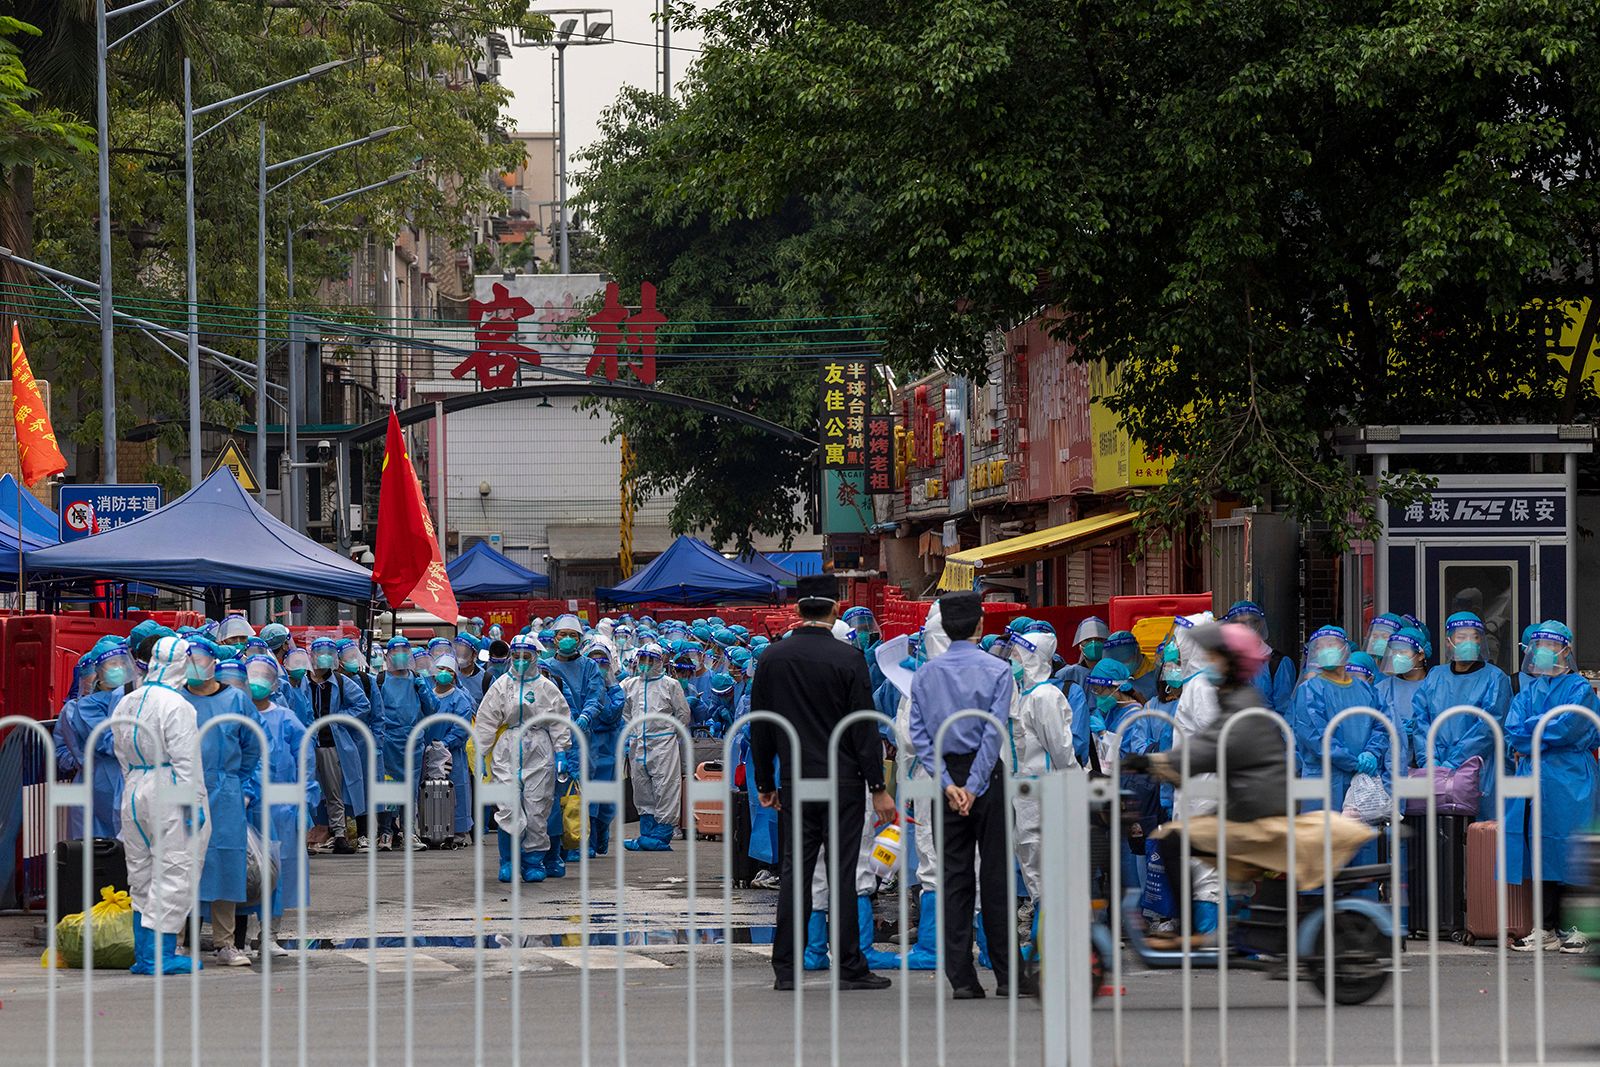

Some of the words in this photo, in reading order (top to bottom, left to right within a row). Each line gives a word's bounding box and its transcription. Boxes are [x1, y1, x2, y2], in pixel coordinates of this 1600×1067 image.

[450, 281, 669, 390] 客村
[824, 363, 845, 465] 友佳公寓
[846, 363, 866, 450] 半球台球城
[869, 419, 890, 490] 烧烤老祖
[97, 495, 157, 512] 消防车道
[1404, 498, 1450, 522] 海珠
[1509, 498, 1555, 522] 保安
